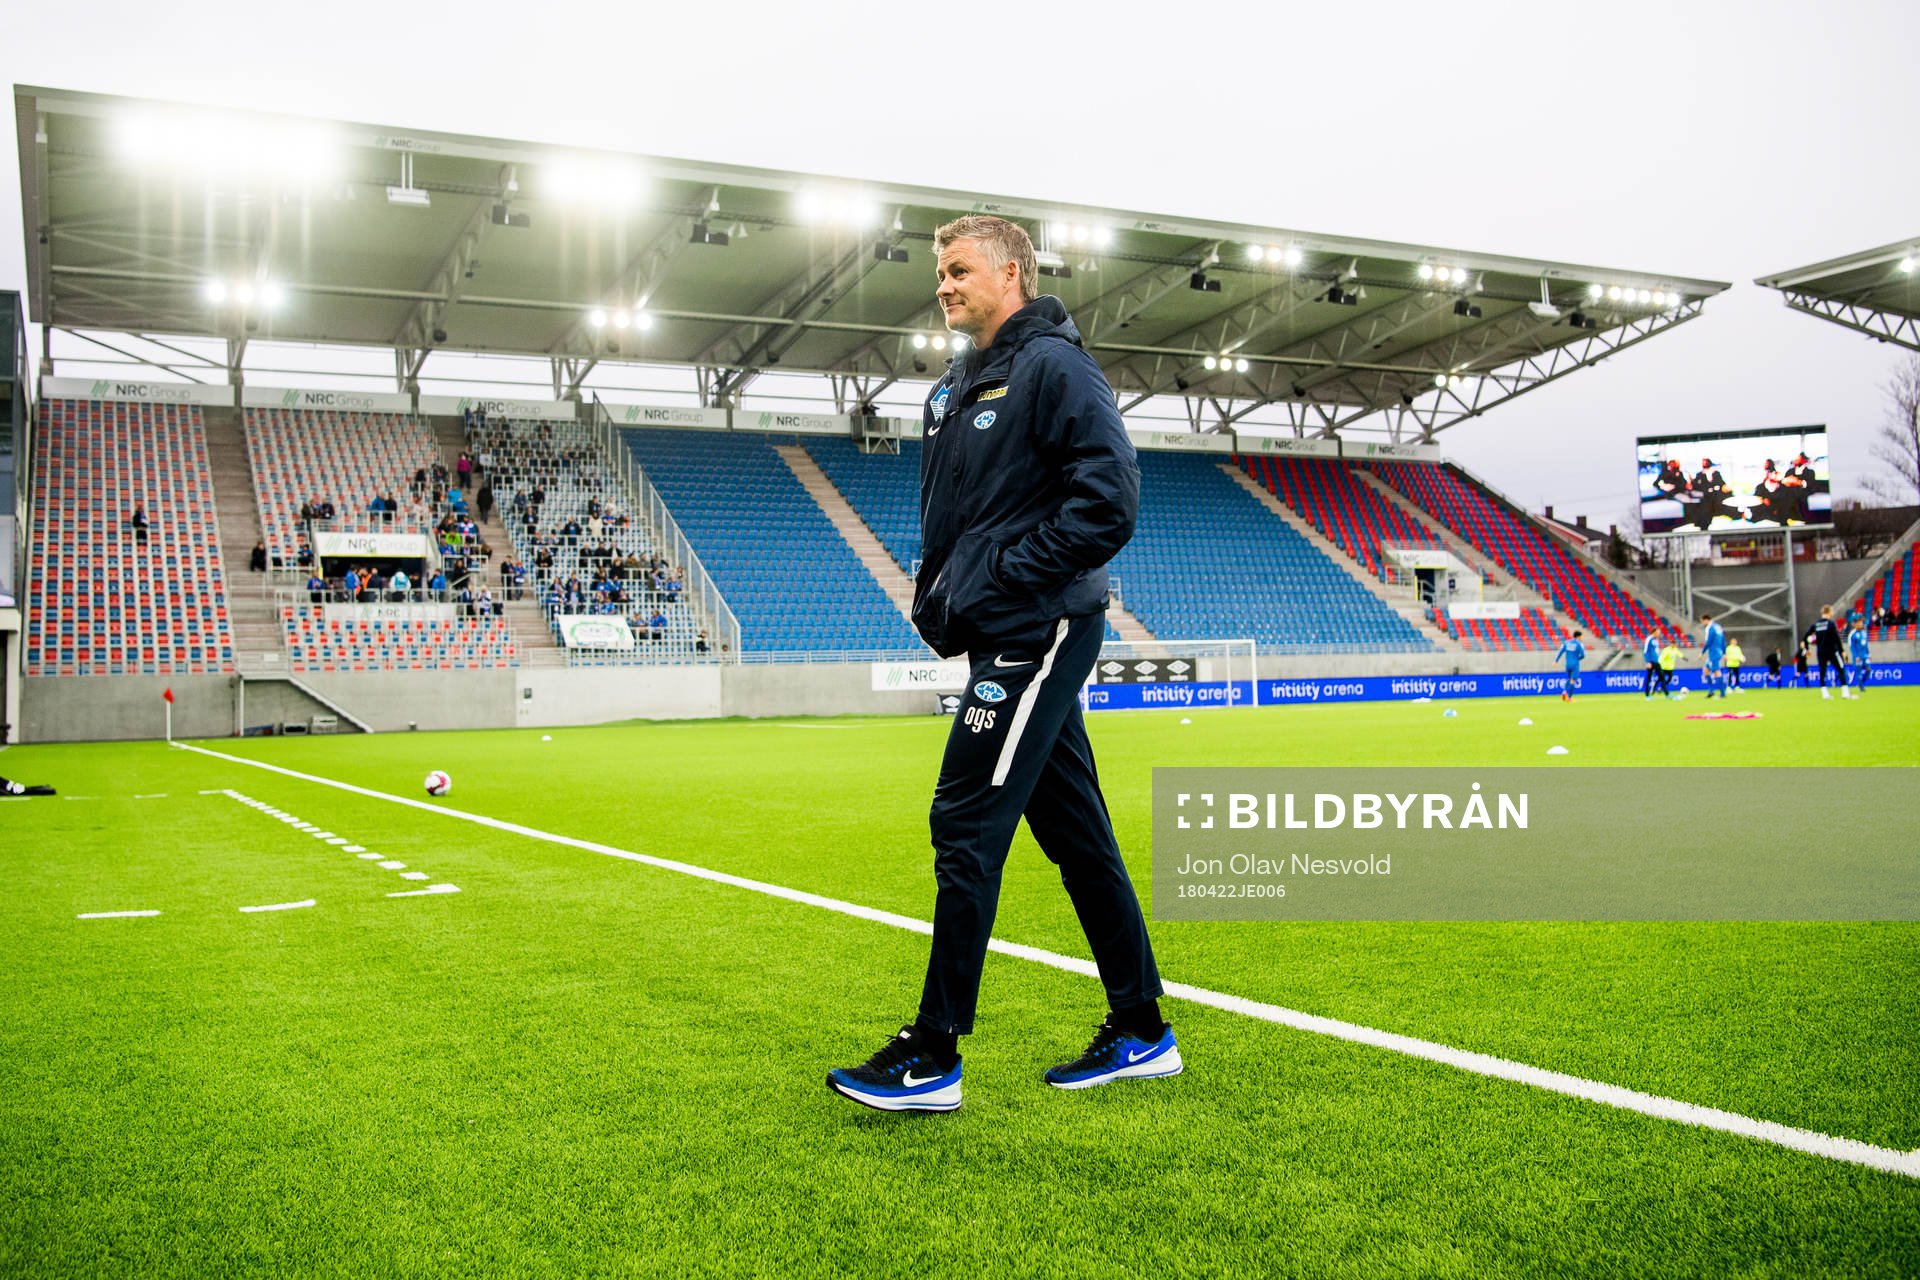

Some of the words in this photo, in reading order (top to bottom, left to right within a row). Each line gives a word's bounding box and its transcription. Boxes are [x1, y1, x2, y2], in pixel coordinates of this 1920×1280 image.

[115, 383, 148, 397] NRC
[150, 384, 191, 400] Group
[304, 392, 335, 406] NRC
[336, 394, 374, 410] Group
[476, 400, 505, 414] NRC
[507, 401, 541, 415] Group
[644, 409, 670, 421] NRC
[671, 410, 703, 424] Group
[776, 415, 800, 428] NRC
[802, 416, 832, 430] Group
[1164, 435, 1184, 446] NRC
[1274, 440, 1293, 450] NRC
[1378, 445, 1396, 455] NRC
[347, 538, 377, 550] NRC
[380, 539, 419, 553] Group
[908, 669, 937, 682] NRC
[939, 668, 969, 682] Grou
[1866, 669, 1903, 681] rena
[1272, 682, 1321, 700] intility
[1323, 683, 1364, 697] arena
[1392, 679, 1437, 697] intility
[1439, 680, 1477, 693] arena
[1503, 675, 1544, 693] intility
[1546, 677, 1582, 690] area
[1142, 685, 1196, 704] intility
[1197, 687, 1241, 701] arena
[964, 706, 997, 733] ogs
